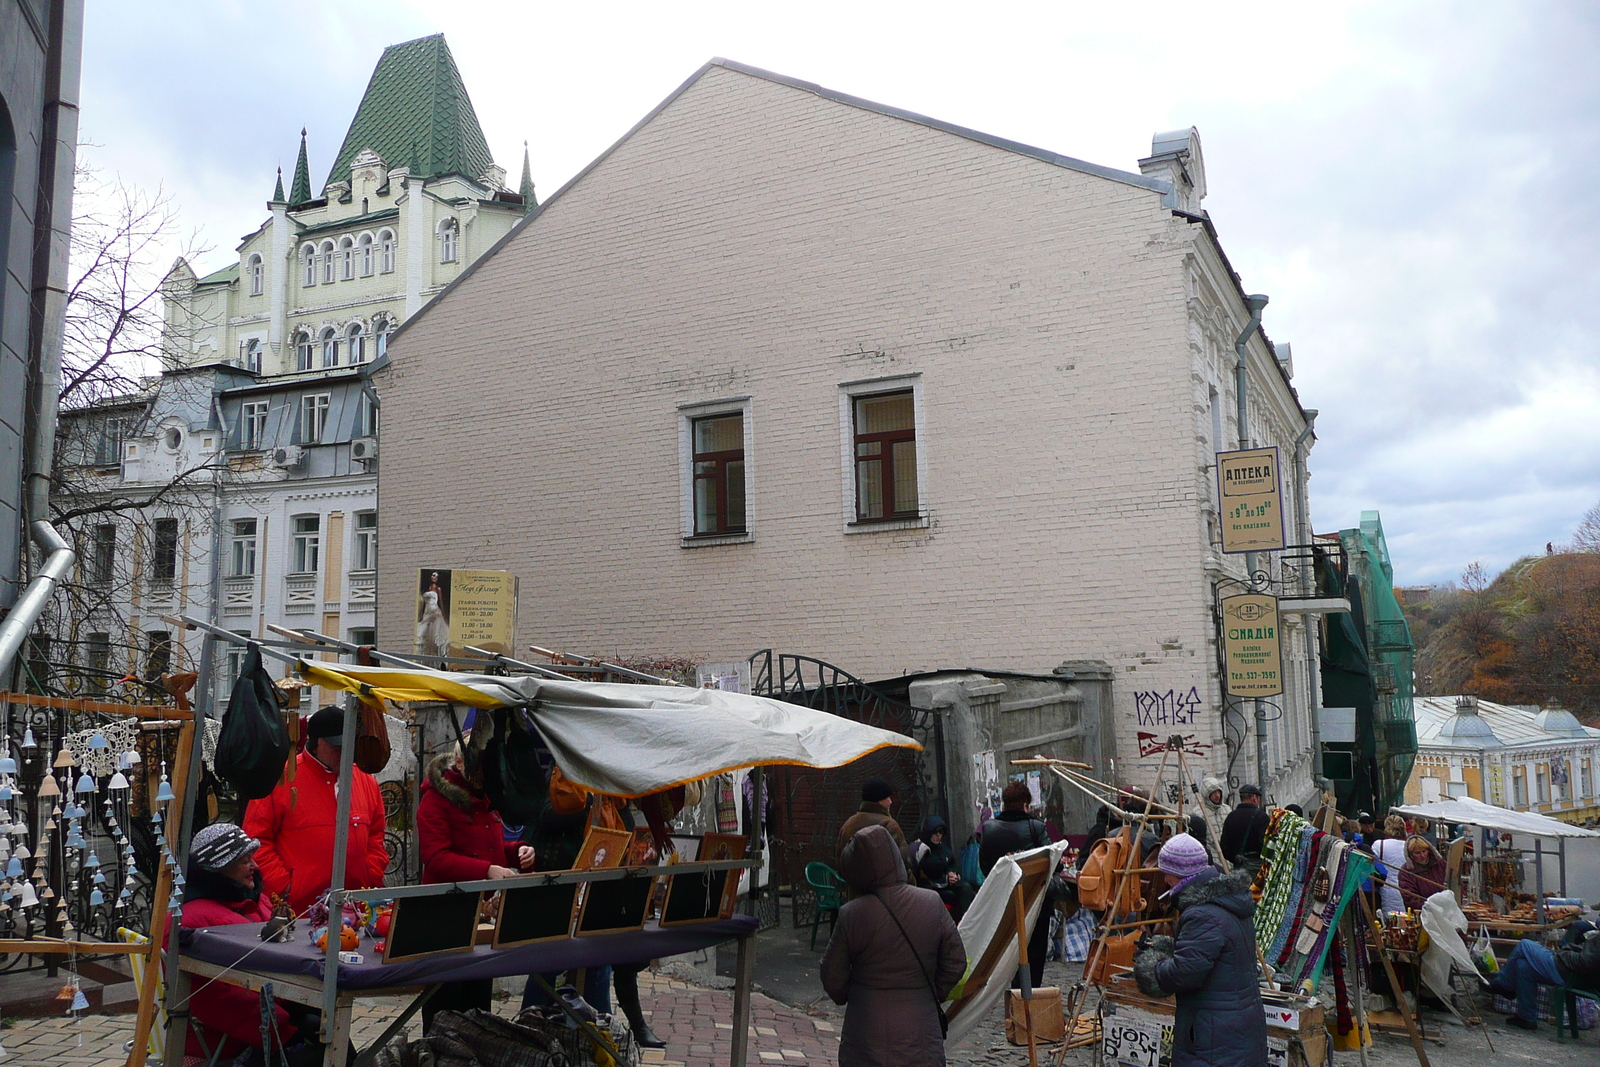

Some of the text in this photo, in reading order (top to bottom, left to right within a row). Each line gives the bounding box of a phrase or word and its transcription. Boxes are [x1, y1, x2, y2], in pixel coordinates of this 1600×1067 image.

[1226, 466, 1270, 480] АПТЕКА
[1246, 509, 1255, 517] до
[1231, 672, 1246, 680] Тел.
